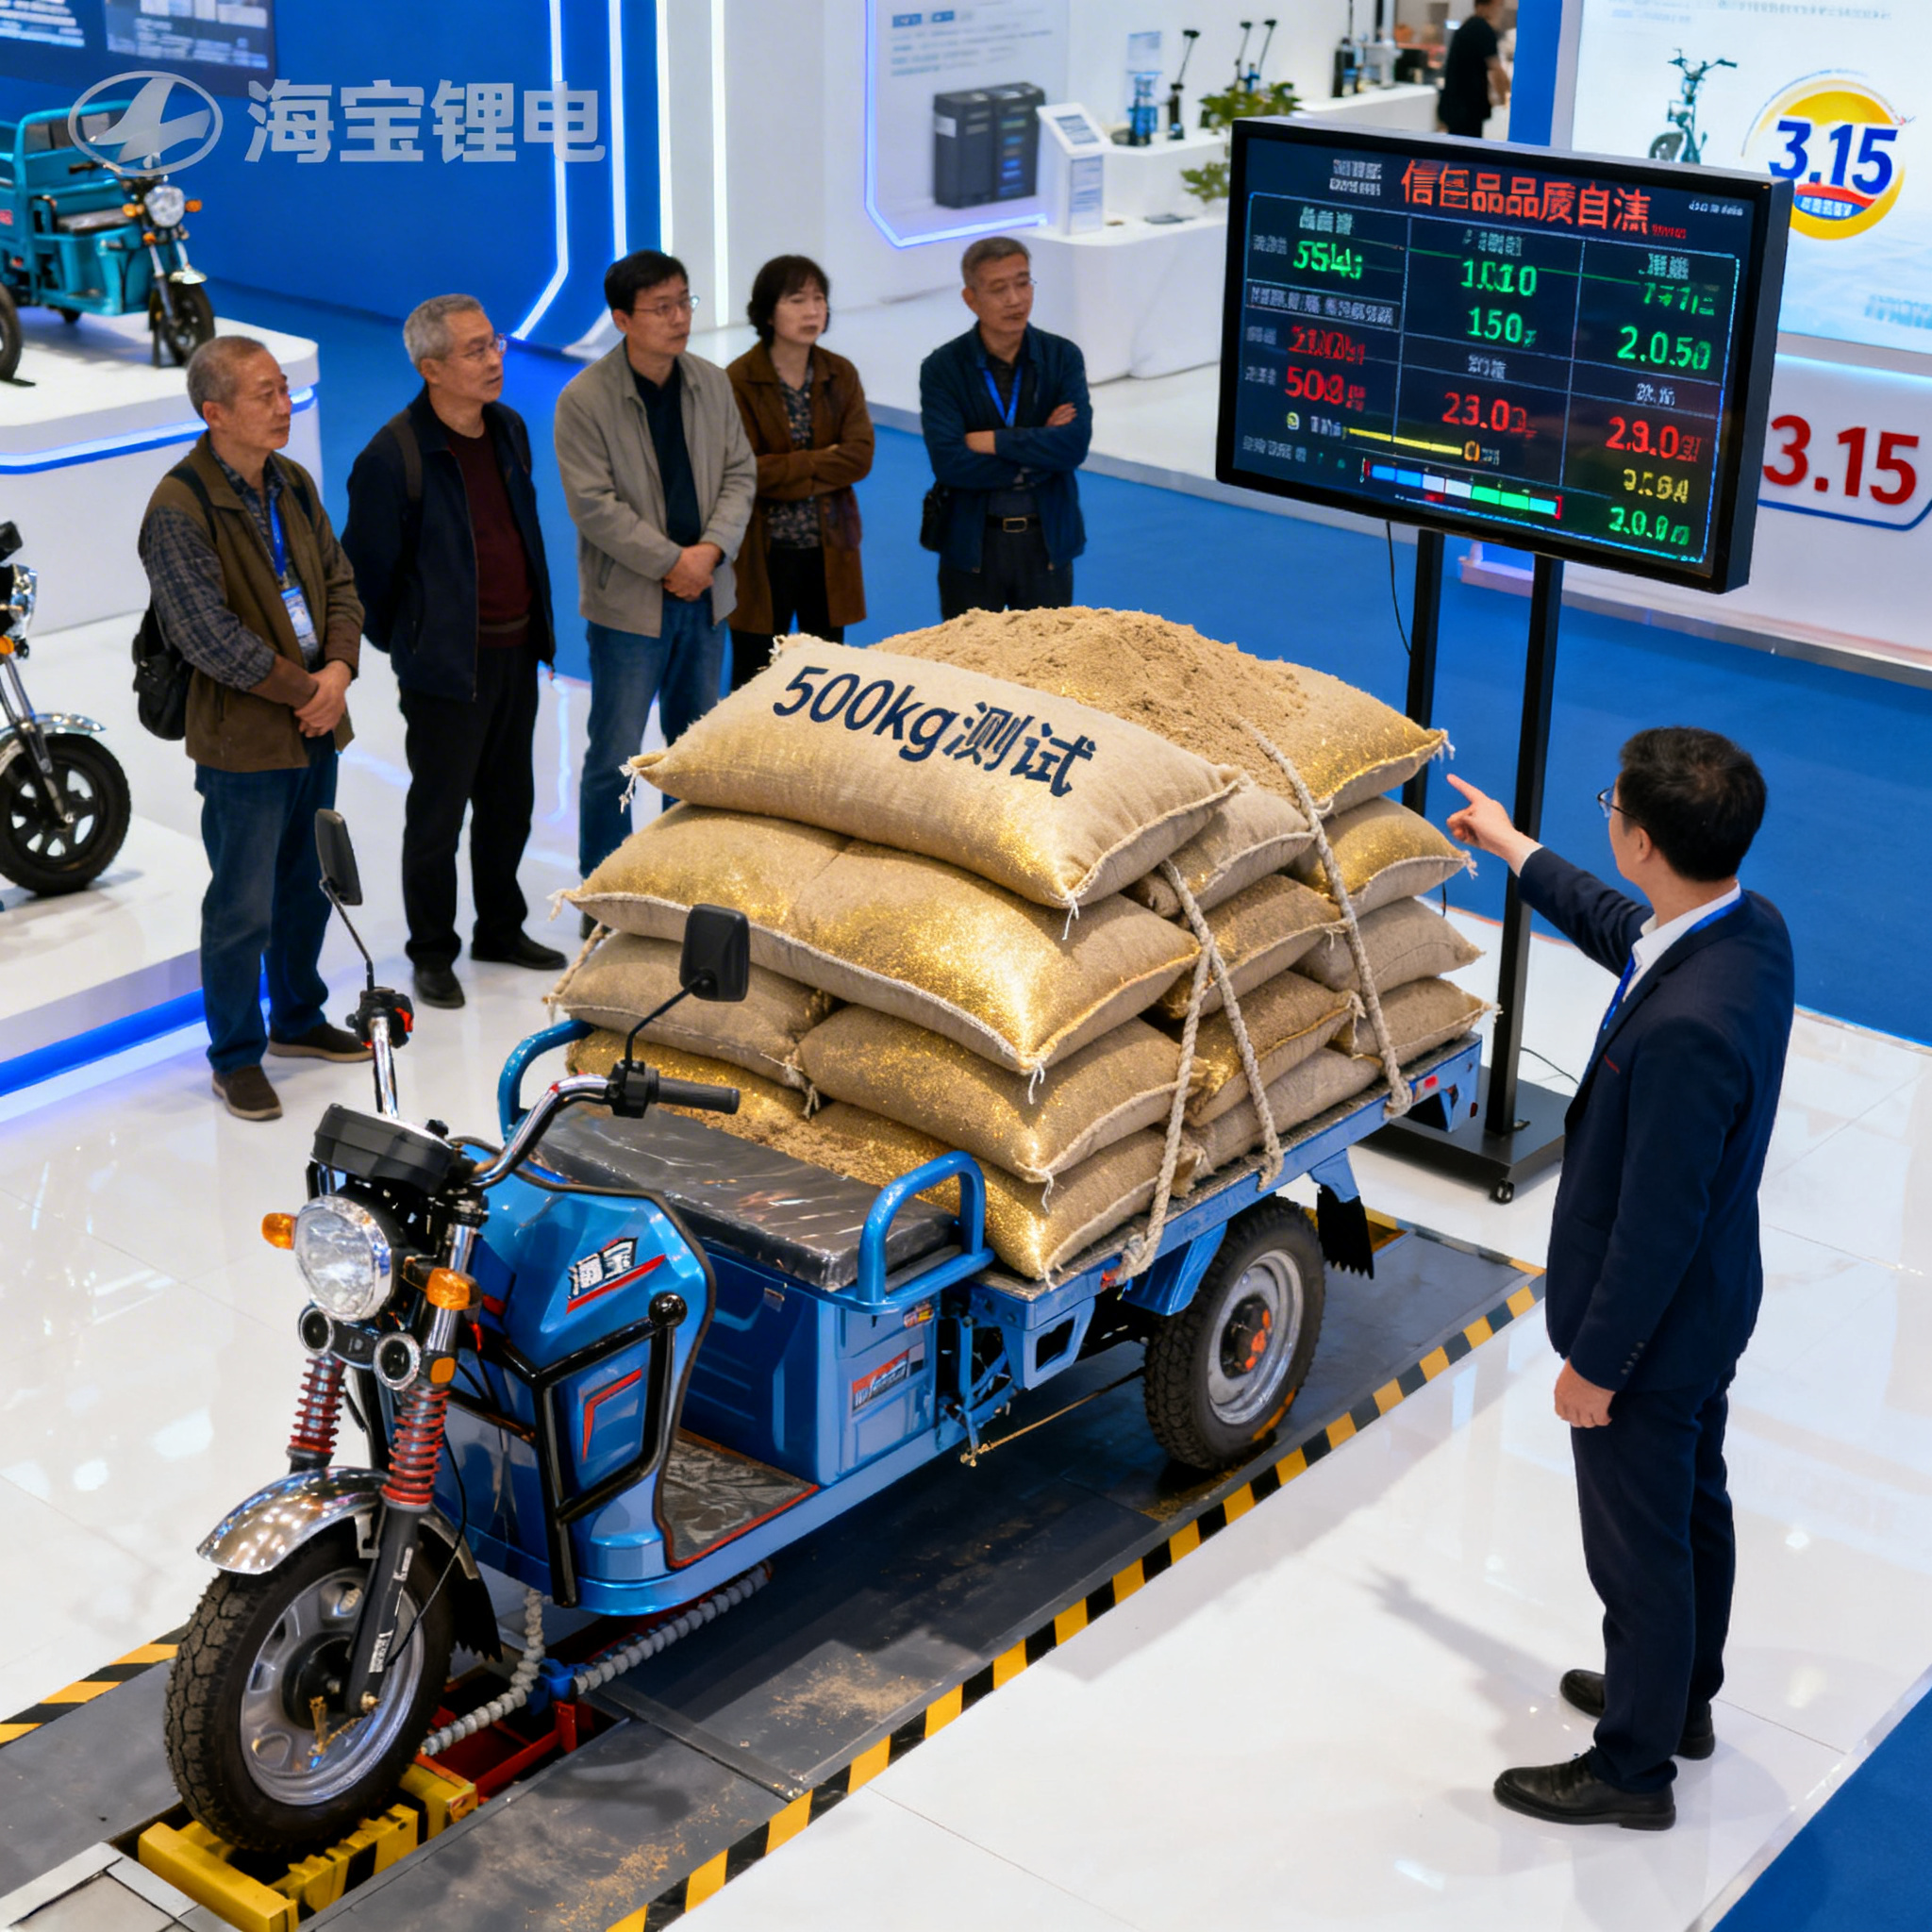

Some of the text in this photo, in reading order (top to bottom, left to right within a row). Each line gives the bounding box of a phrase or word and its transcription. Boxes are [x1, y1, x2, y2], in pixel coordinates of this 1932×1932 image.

[1769, 120, 1898, 195] 3.15
[1762, 414, 1920, 506] 3.15
[773, 665, 1097, 798] 500kg测试
